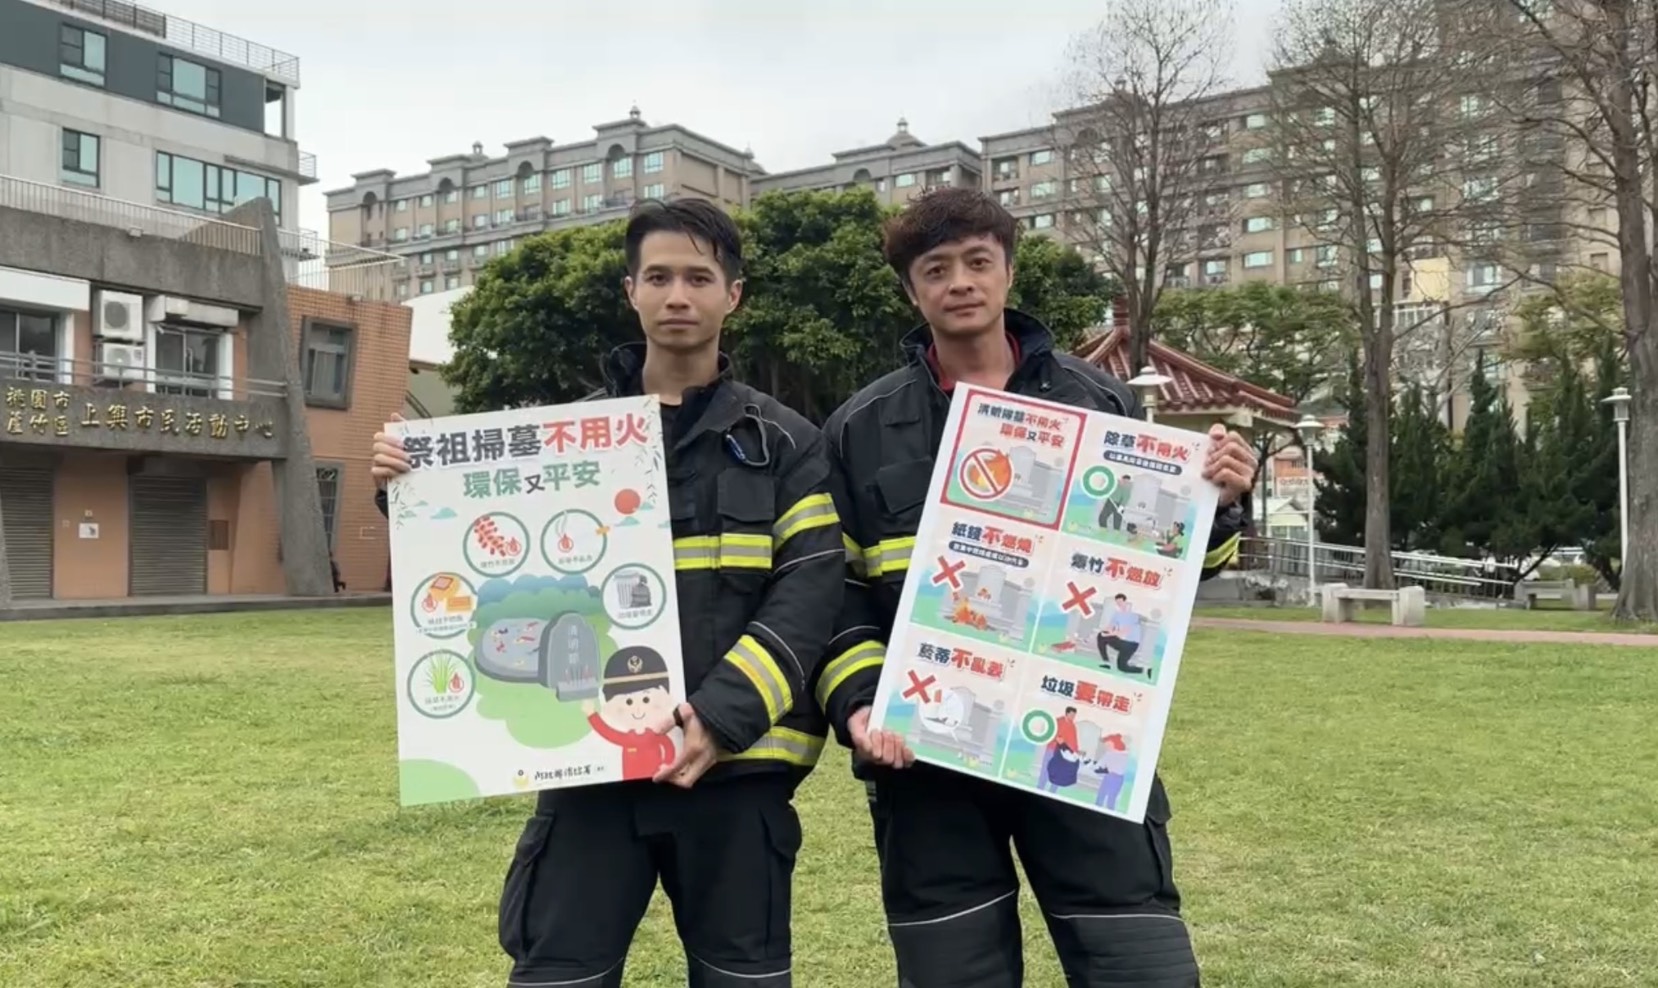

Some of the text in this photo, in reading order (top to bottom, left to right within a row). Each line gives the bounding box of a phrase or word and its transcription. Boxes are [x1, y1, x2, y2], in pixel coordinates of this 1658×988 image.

[6, 387, 71, 409] 桃園市
[7, 411, 69, 436] 蘆竹區
[81, 403, 274, 438] 上興市民活動中心
[999, 423, 1065, 448] 環保又平安
[402, 413, 649, 469] 祭祖掃墓不用火
[1103, 430, 1188, 461] 除草不用火
[463, 460, 601, 499] 環保又平安
[1070, 552, 1162, 588] 爆竹不燃放
[1041, 674, 1133, 712] 垃圾要帶走
